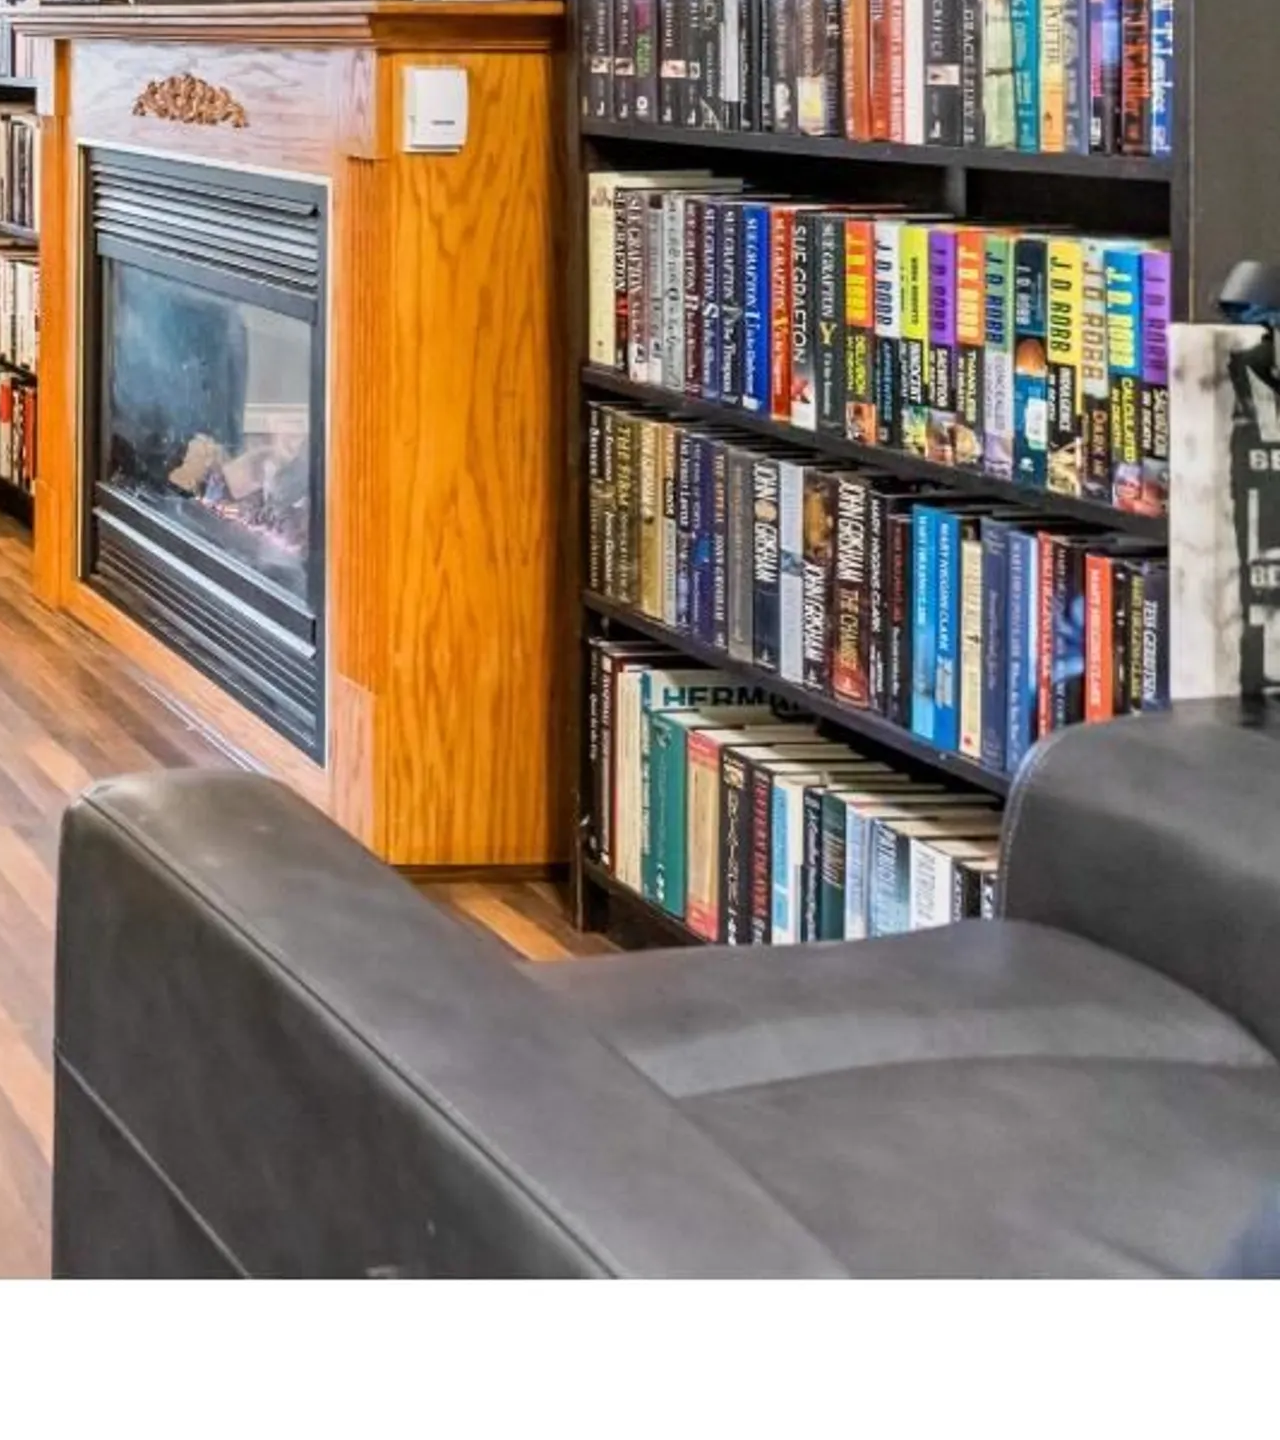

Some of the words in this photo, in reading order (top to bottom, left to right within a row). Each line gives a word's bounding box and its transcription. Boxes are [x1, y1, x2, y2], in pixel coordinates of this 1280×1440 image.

[963, 9, 975, 62] GRACE
[627, 227, 644, 294] GRAFTON
[792, 225, 806, 262] SUE
[821, 223, 835, 252] SUE
[822, 255, 835, 317] GRAFTON
[847, 273, 867, 320] ROBB
[875, 280, 893, 326] ROBB
[792, 266, 807, 365] GRAFTON
[820, 321, 838, 347] Y
[957, 287, 979, 338] ROBB
[985, 294, 1004, 344] ROBB
[1050, 301, 1072, 352] ROBB
[1081, 312, 1104, 381] ROBB
[1107, 313, 1135, 369] ROBB
[1143, 317, 1167, 377] ROBB
[908, 341, 921, 403] INNOCENT
[965, 350, 977, 423] THANKLESS
[1058, 367, 1072, 432] INDULGENCE
[1121, 376, 1135, 464] CALCULATED
[617, 426, 631, 461] THE
[1092, 409, 1107, 454] DARK
[617, 463, 631, 507] FIRM
[754, 463, 778, 501] JOHN
[838, 479, 865, 519] JOHN
[754, 522, 777, 582] GRISHAM
[837, 518, 864, 582] GRISHAM
[804, 561, 824, 603] JOHN
[840, 588, 859, 613] THE
[804, 603, 824, 661] GRISHAM
[1142, 599, 1157, 630] TESS
[840, 613, 859, 671] CHAMBER
[1142, 630, 1158, 703] GERRITSEN
[982, 883, 993, 920] KAT
